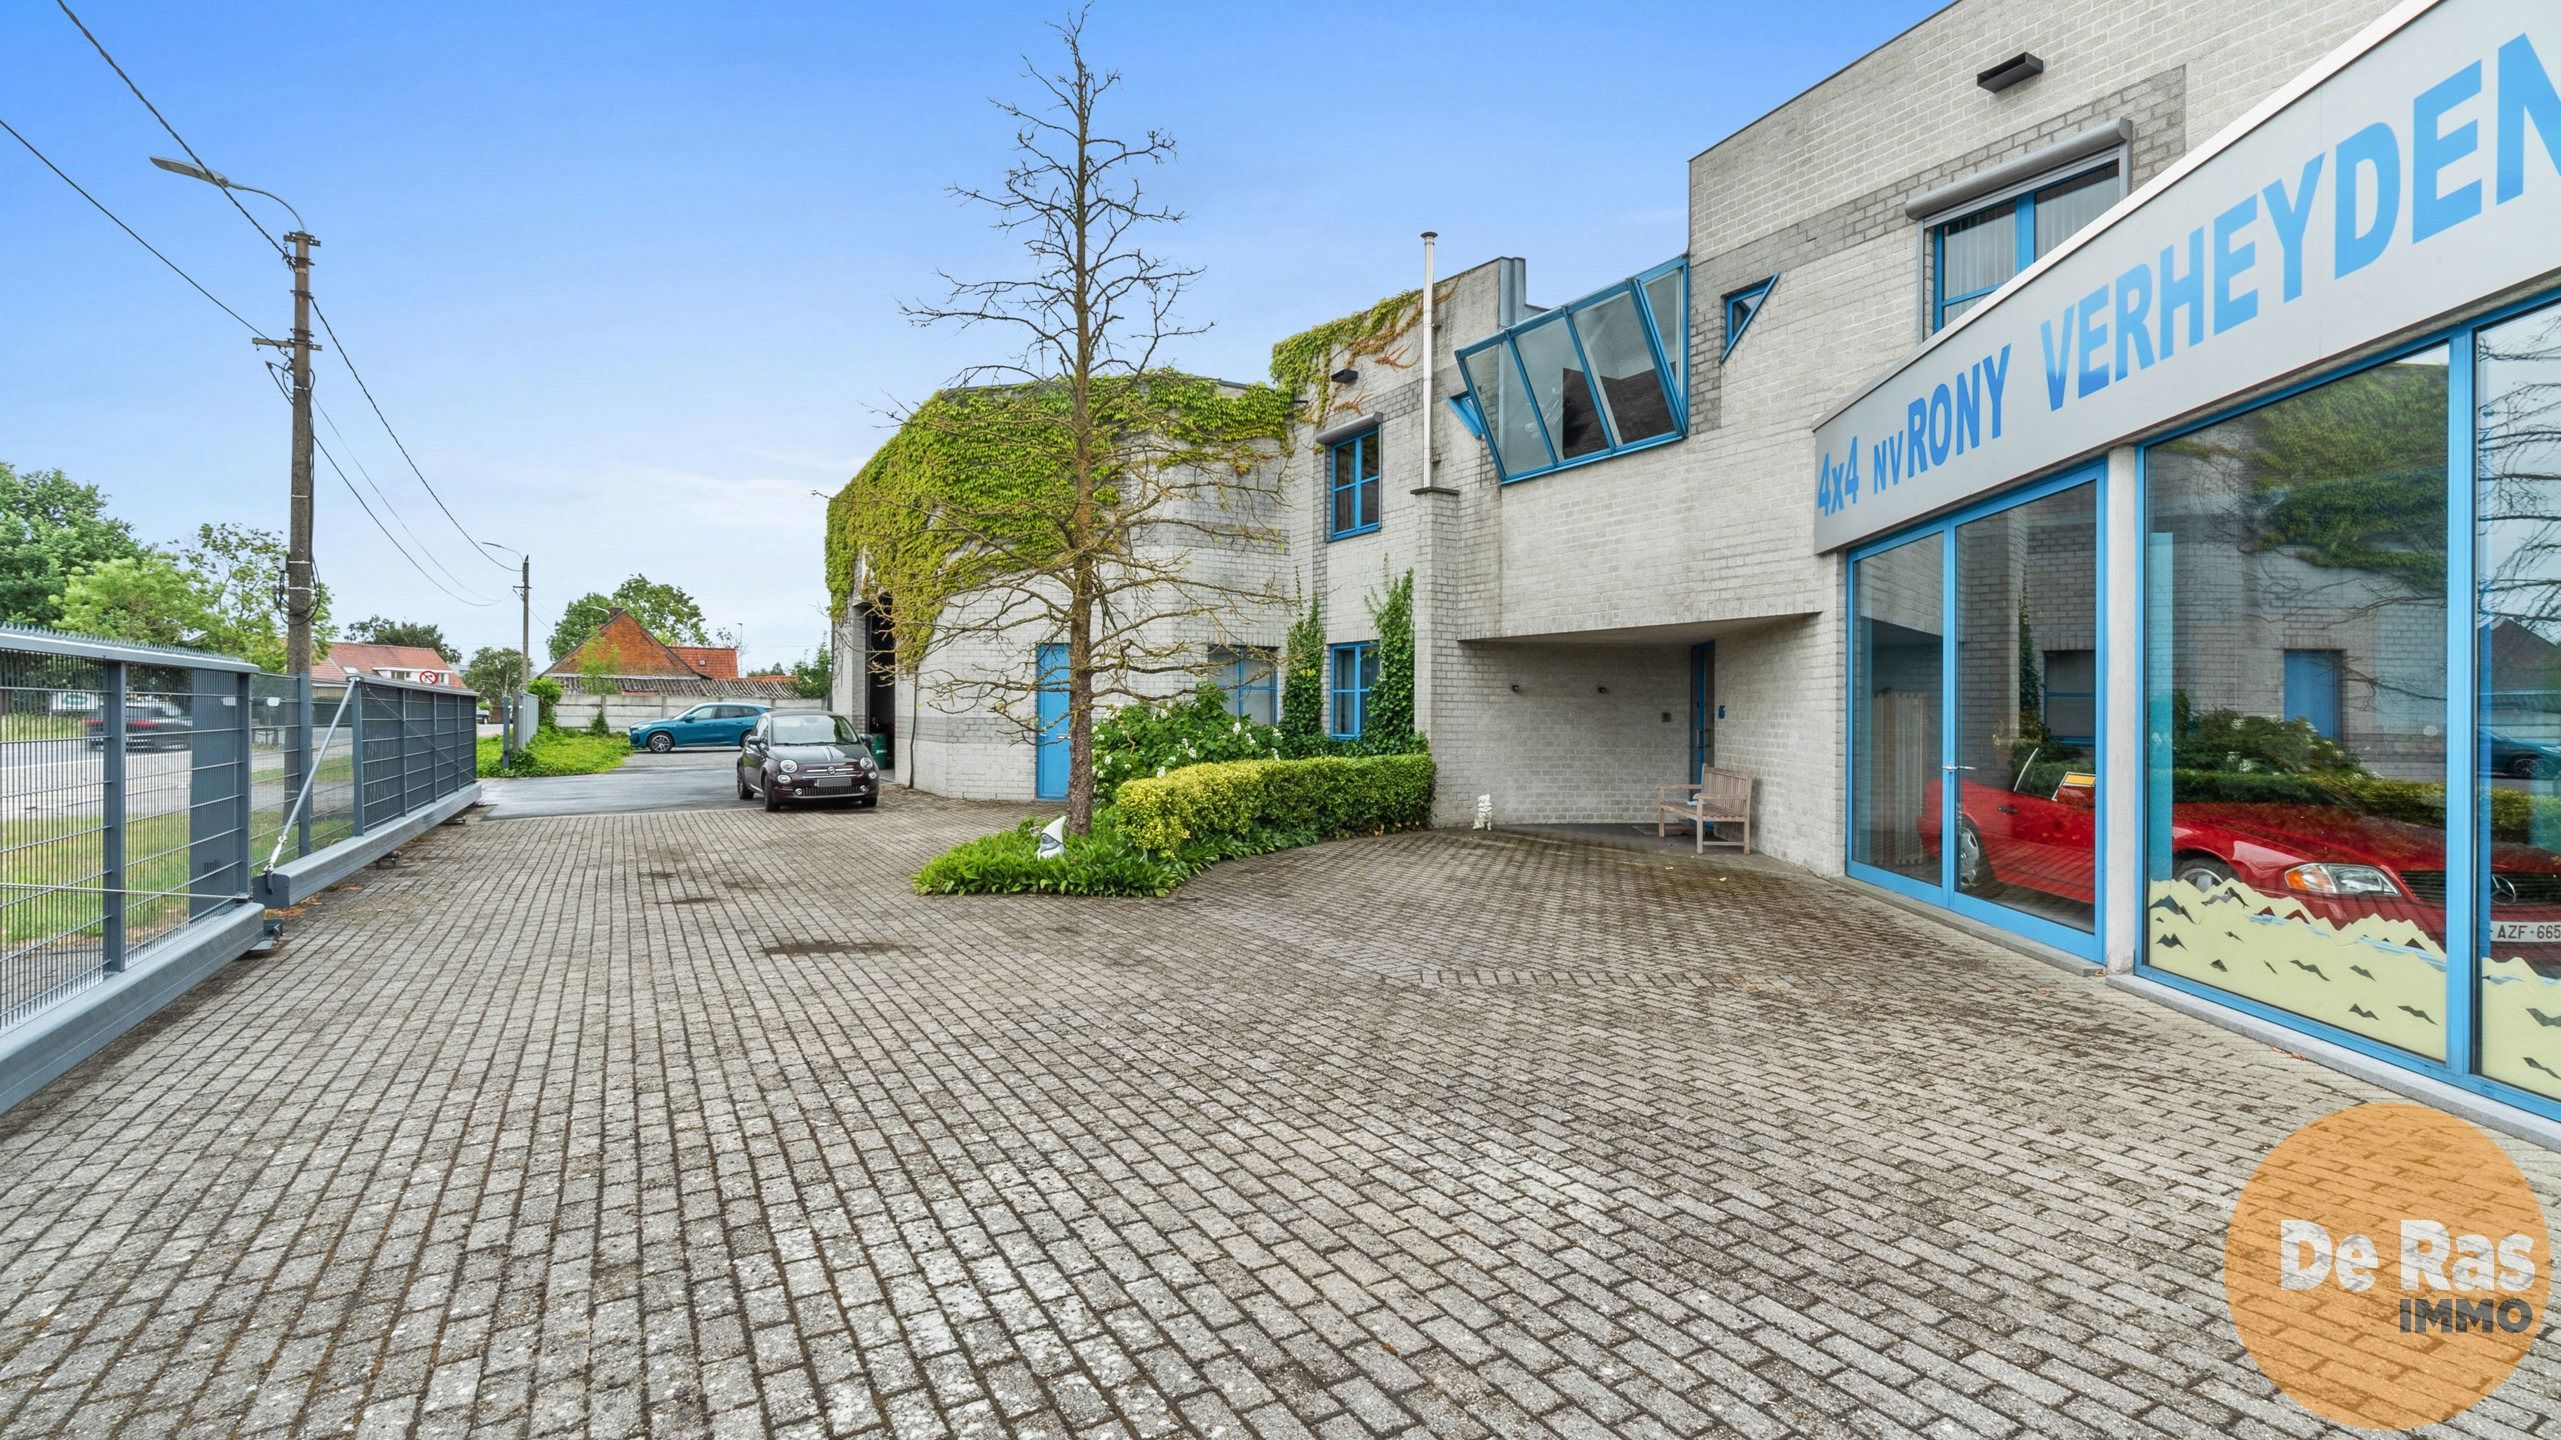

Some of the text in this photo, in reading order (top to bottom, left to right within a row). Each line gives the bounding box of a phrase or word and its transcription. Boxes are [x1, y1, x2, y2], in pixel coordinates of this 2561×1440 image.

[1817, 33, 2561, 517] 4x4 NV RONY VERHEYDEN
